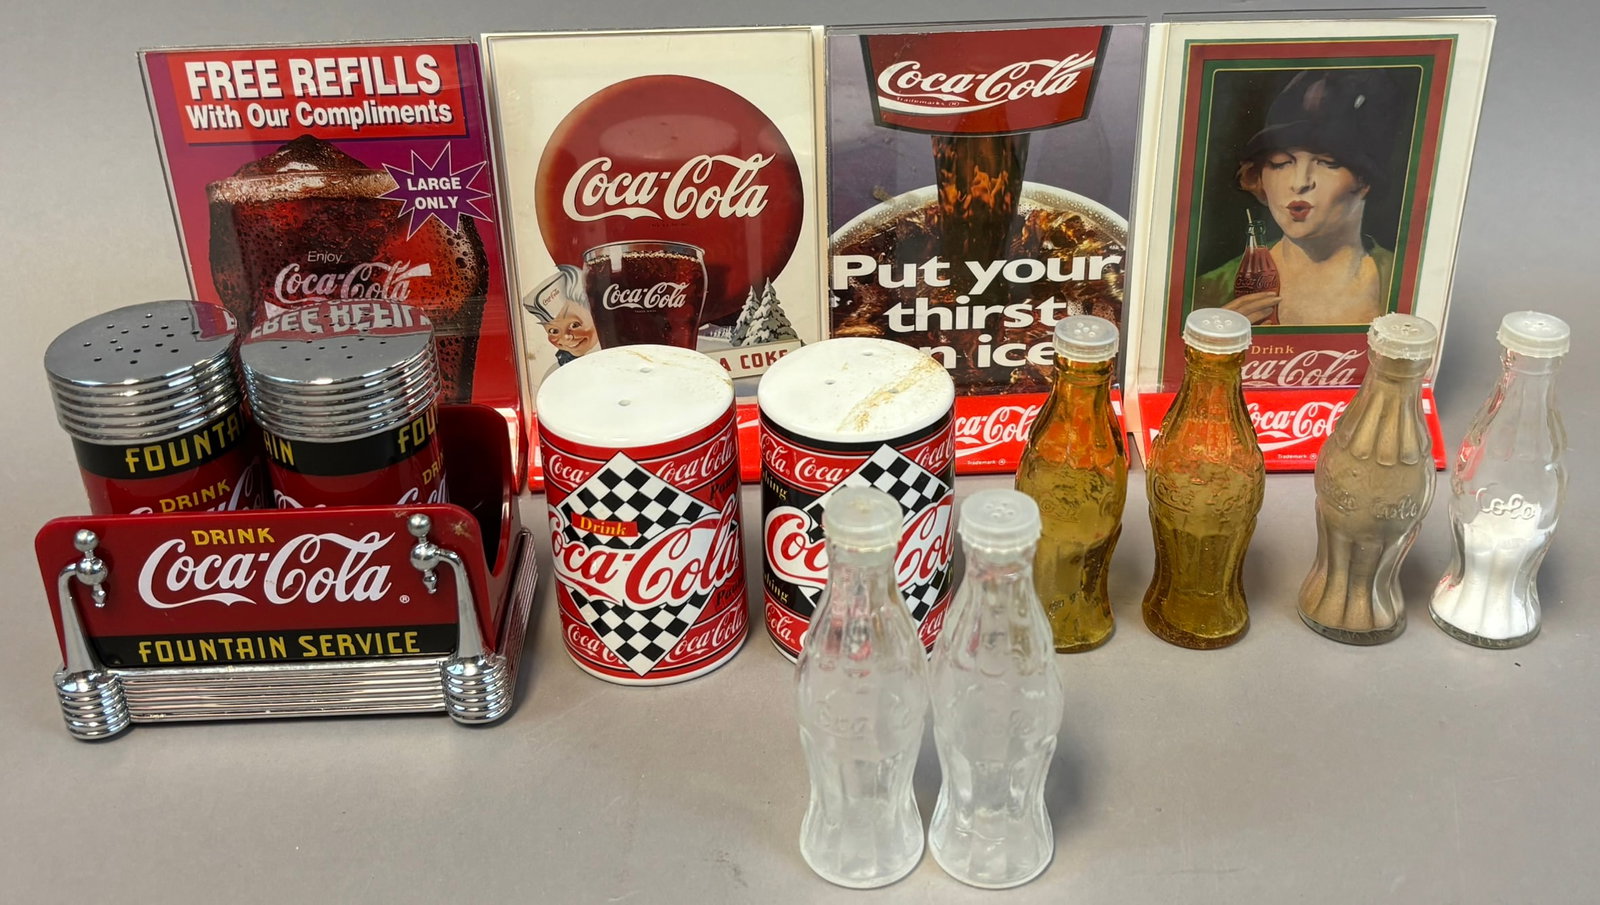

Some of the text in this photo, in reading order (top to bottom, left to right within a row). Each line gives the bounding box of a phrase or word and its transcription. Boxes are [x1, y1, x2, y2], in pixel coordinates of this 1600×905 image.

[185, 54, 442, 100] FREE REFILLS
[877, 50, 1096, 104] Coca-Cola
[185, 99, 453, 131] With Our Compliments
[406, 176, 462, 192] LARGE
[562, 152, 777, 222] Coca-Cola
[414, 195, 460, 211] ONLY
[306, 249, 344, 264] Enjoy
[274, 258, 432, 305] Coca-Cola
[832, 253, 1123, 296] Put your
[602, 281, 691, 311] Coca-Cola
[883, 295, 1068, 333] thirst
[977, 333, 1056, 369] ice
[1251, 345, 1295, 355] Drink
[1241, 349, 1367, 387] ca-Cola
[125, 411, 241, 474] FOUNTA
[549, 454, 590, 488] Coca-
[794, 456, 850, 488] Coca-
[159, 478, 231, 513] DRINK
[192, 527, 275, 547] DRINK
[579, 516, 627, 536] Drink
[137, 531, 395, 609] Coca-Cola
[138, 630, 421, 664] FOUNTAIN SERVICE
